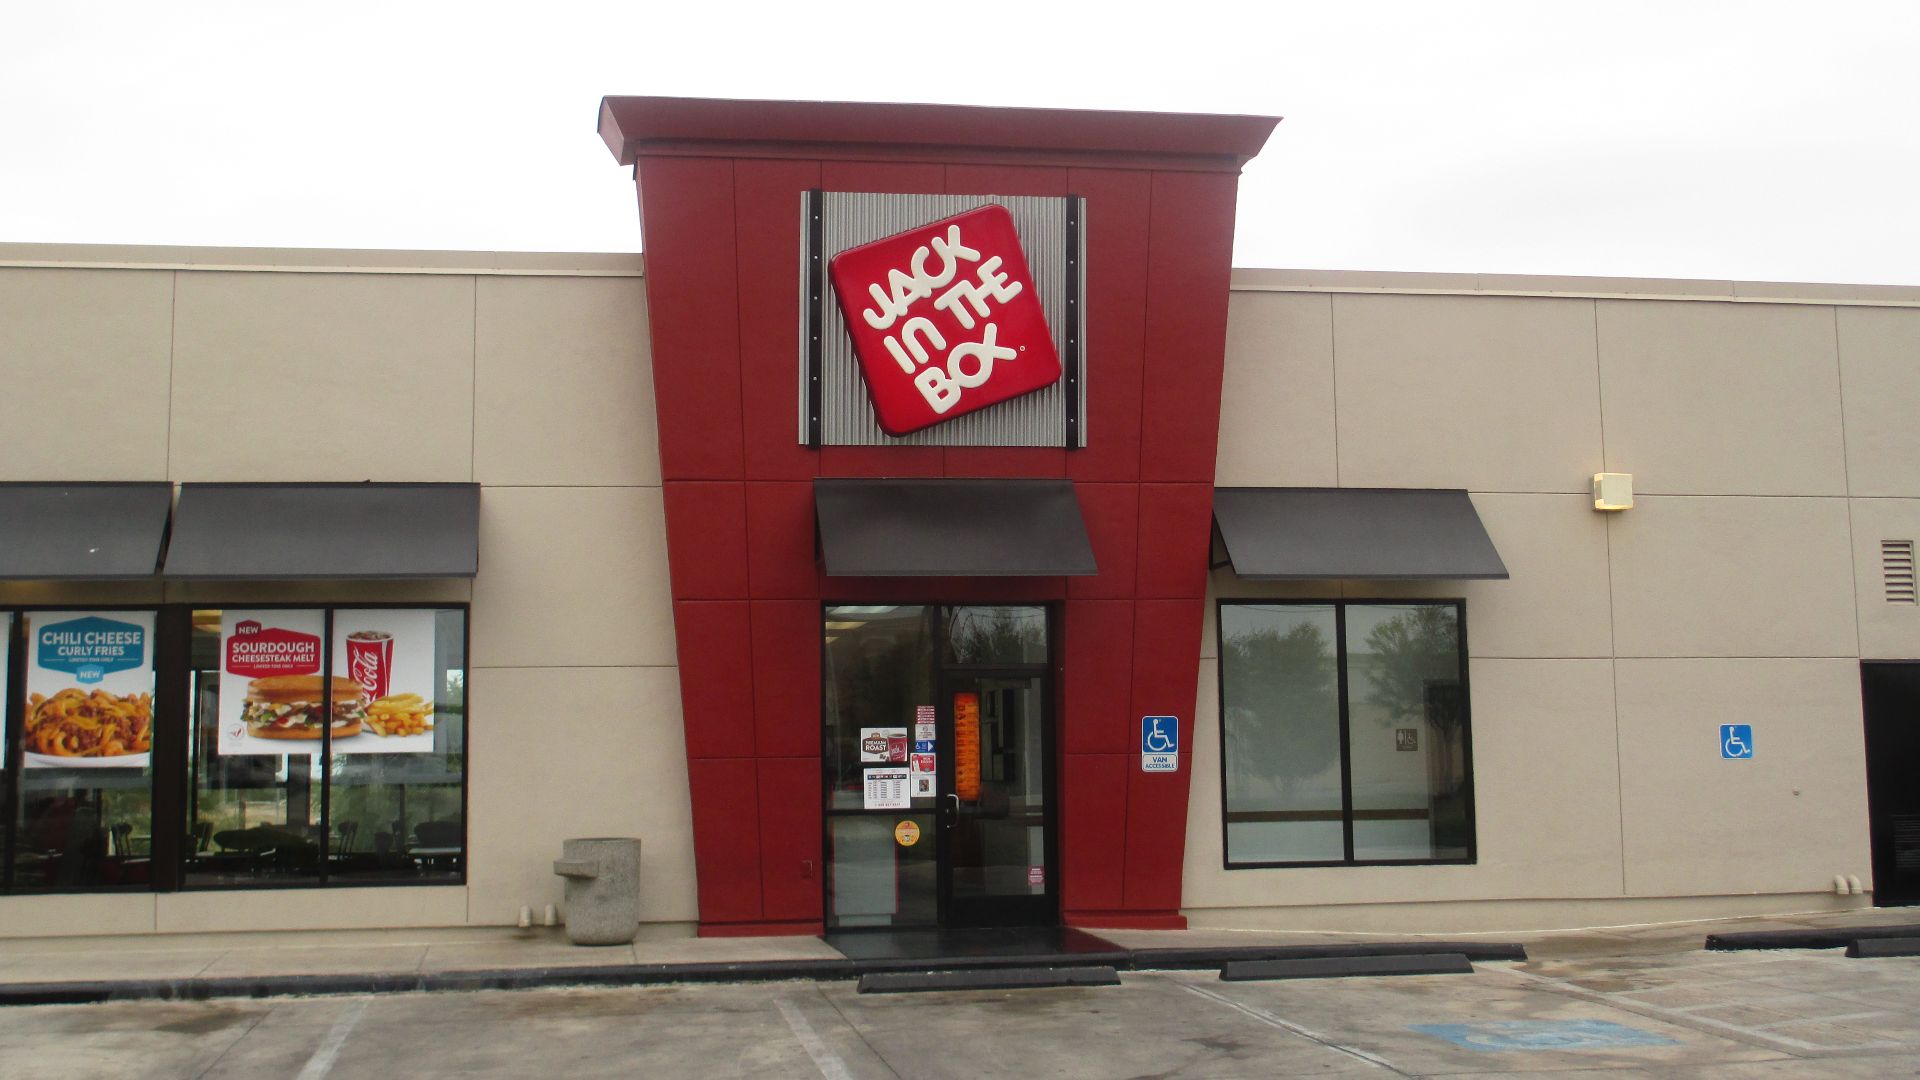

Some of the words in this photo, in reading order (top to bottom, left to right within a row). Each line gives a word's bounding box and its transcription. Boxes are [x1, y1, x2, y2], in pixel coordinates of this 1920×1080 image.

[863, 224, 981, 330] JACK
[934, 255, 1023, 330] THE
[914, 322, 1017, 415] BOX
[239, 626, 259, 634] NEW
[42, 631, 81, 645] CHILI
[84, 631, 141, 645] CHEESE
[57, 646, 92, 656] CURLY
[94, 646, 125, 656] FRIES
[232, 642, 315, 653] SOURDOUGH
[232, 654, 292, 663] CHEESESTEAK
[293, 654, 315, 662] MELT
[80, 671, 101, 679] NEW
